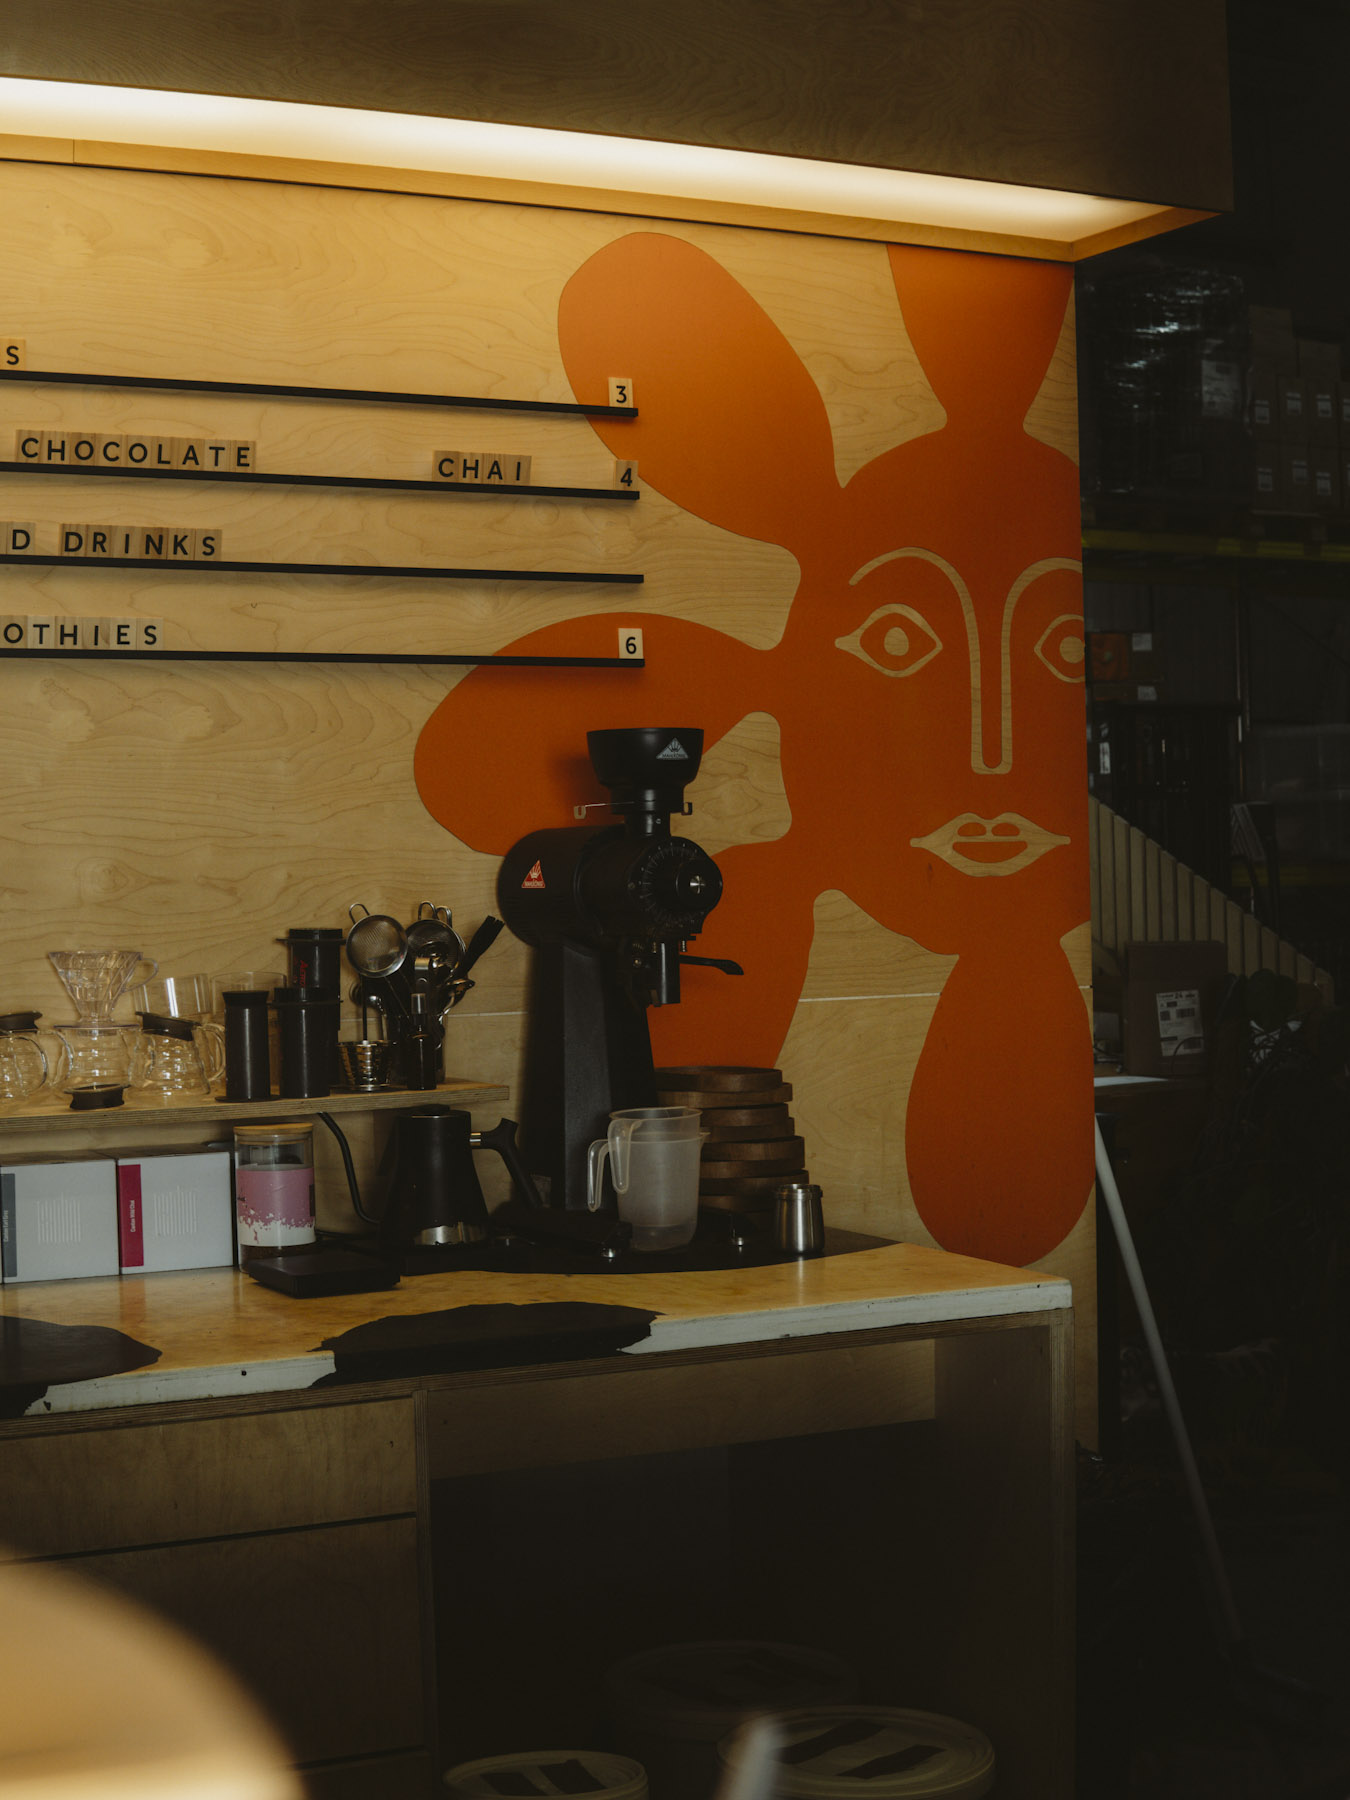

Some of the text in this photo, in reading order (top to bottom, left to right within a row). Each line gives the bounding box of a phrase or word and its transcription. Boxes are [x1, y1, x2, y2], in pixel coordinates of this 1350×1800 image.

[6, 345, 19, 365] S
[616, 385, 627, 404] 3
[21, 437, 250, 467] CHOCOLATE
[438, 458, 521, 481] CHAI
[620, 467, 633, 487] 4
[12, 529, 215, 556] D DRINKS
[3, 622, 157, 646] OTHIES
[625, 636, 637, 655] 6
